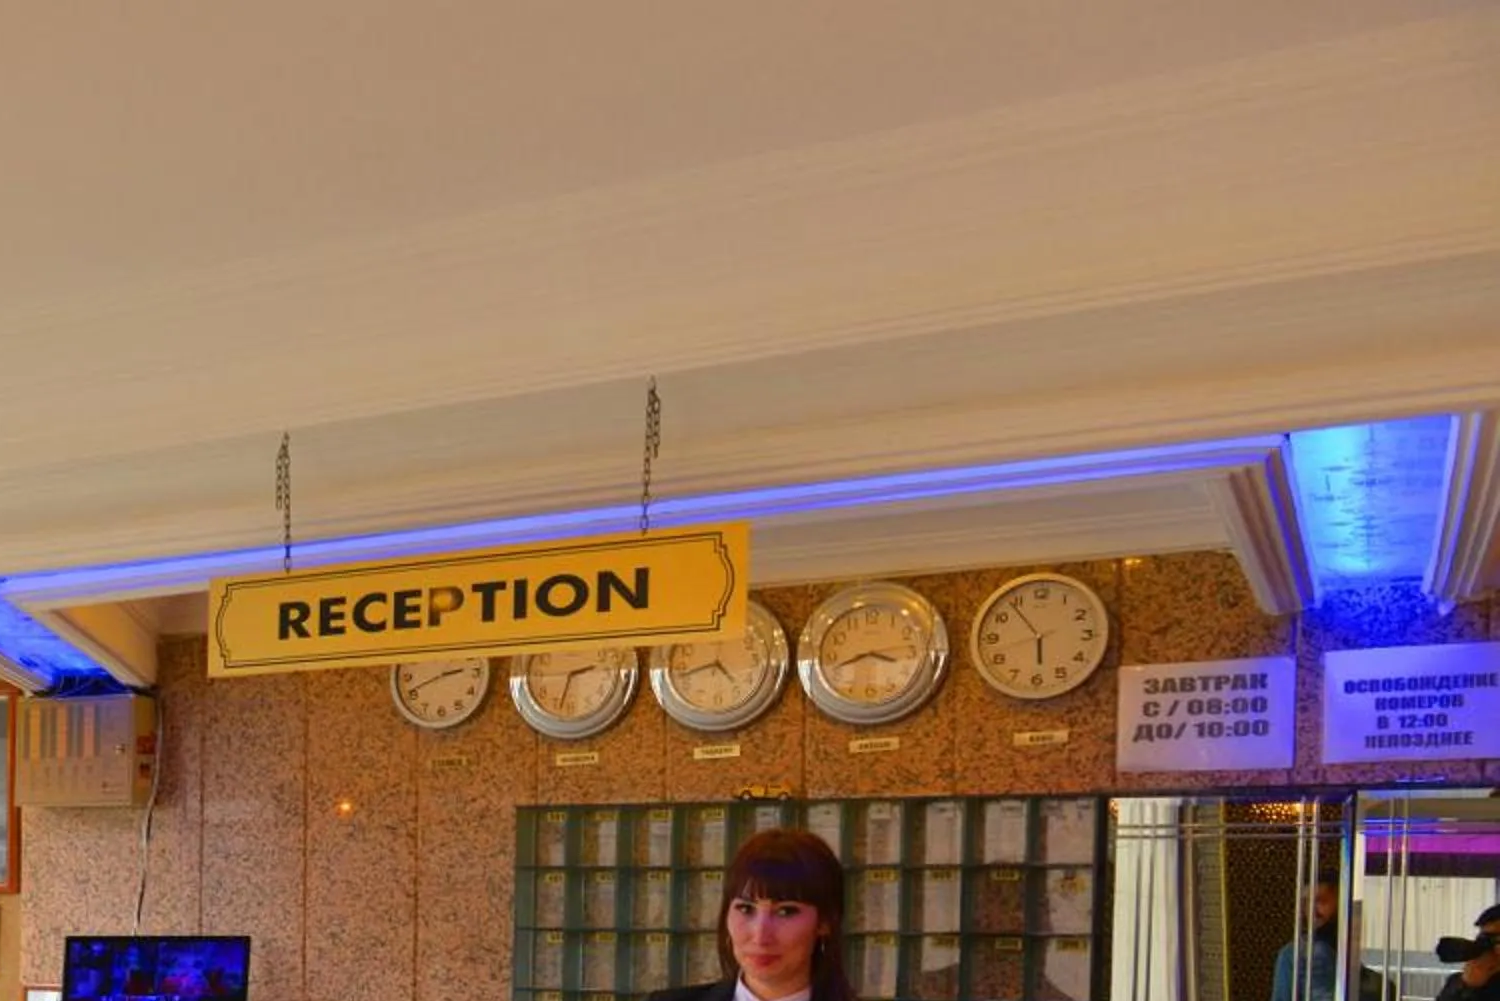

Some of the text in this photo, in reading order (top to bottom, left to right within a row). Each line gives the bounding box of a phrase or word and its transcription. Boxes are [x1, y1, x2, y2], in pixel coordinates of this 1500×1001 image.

[277, 566, 651, 641] RECEPTION
[1143, 673, 1269, 695] ЗАВТРАК
[1186, 696, 1269, 716] 08:00
[1375, 693, 1465, 711] НОМЕРОВ
[1398, 713, 1449, 729] 12:00
